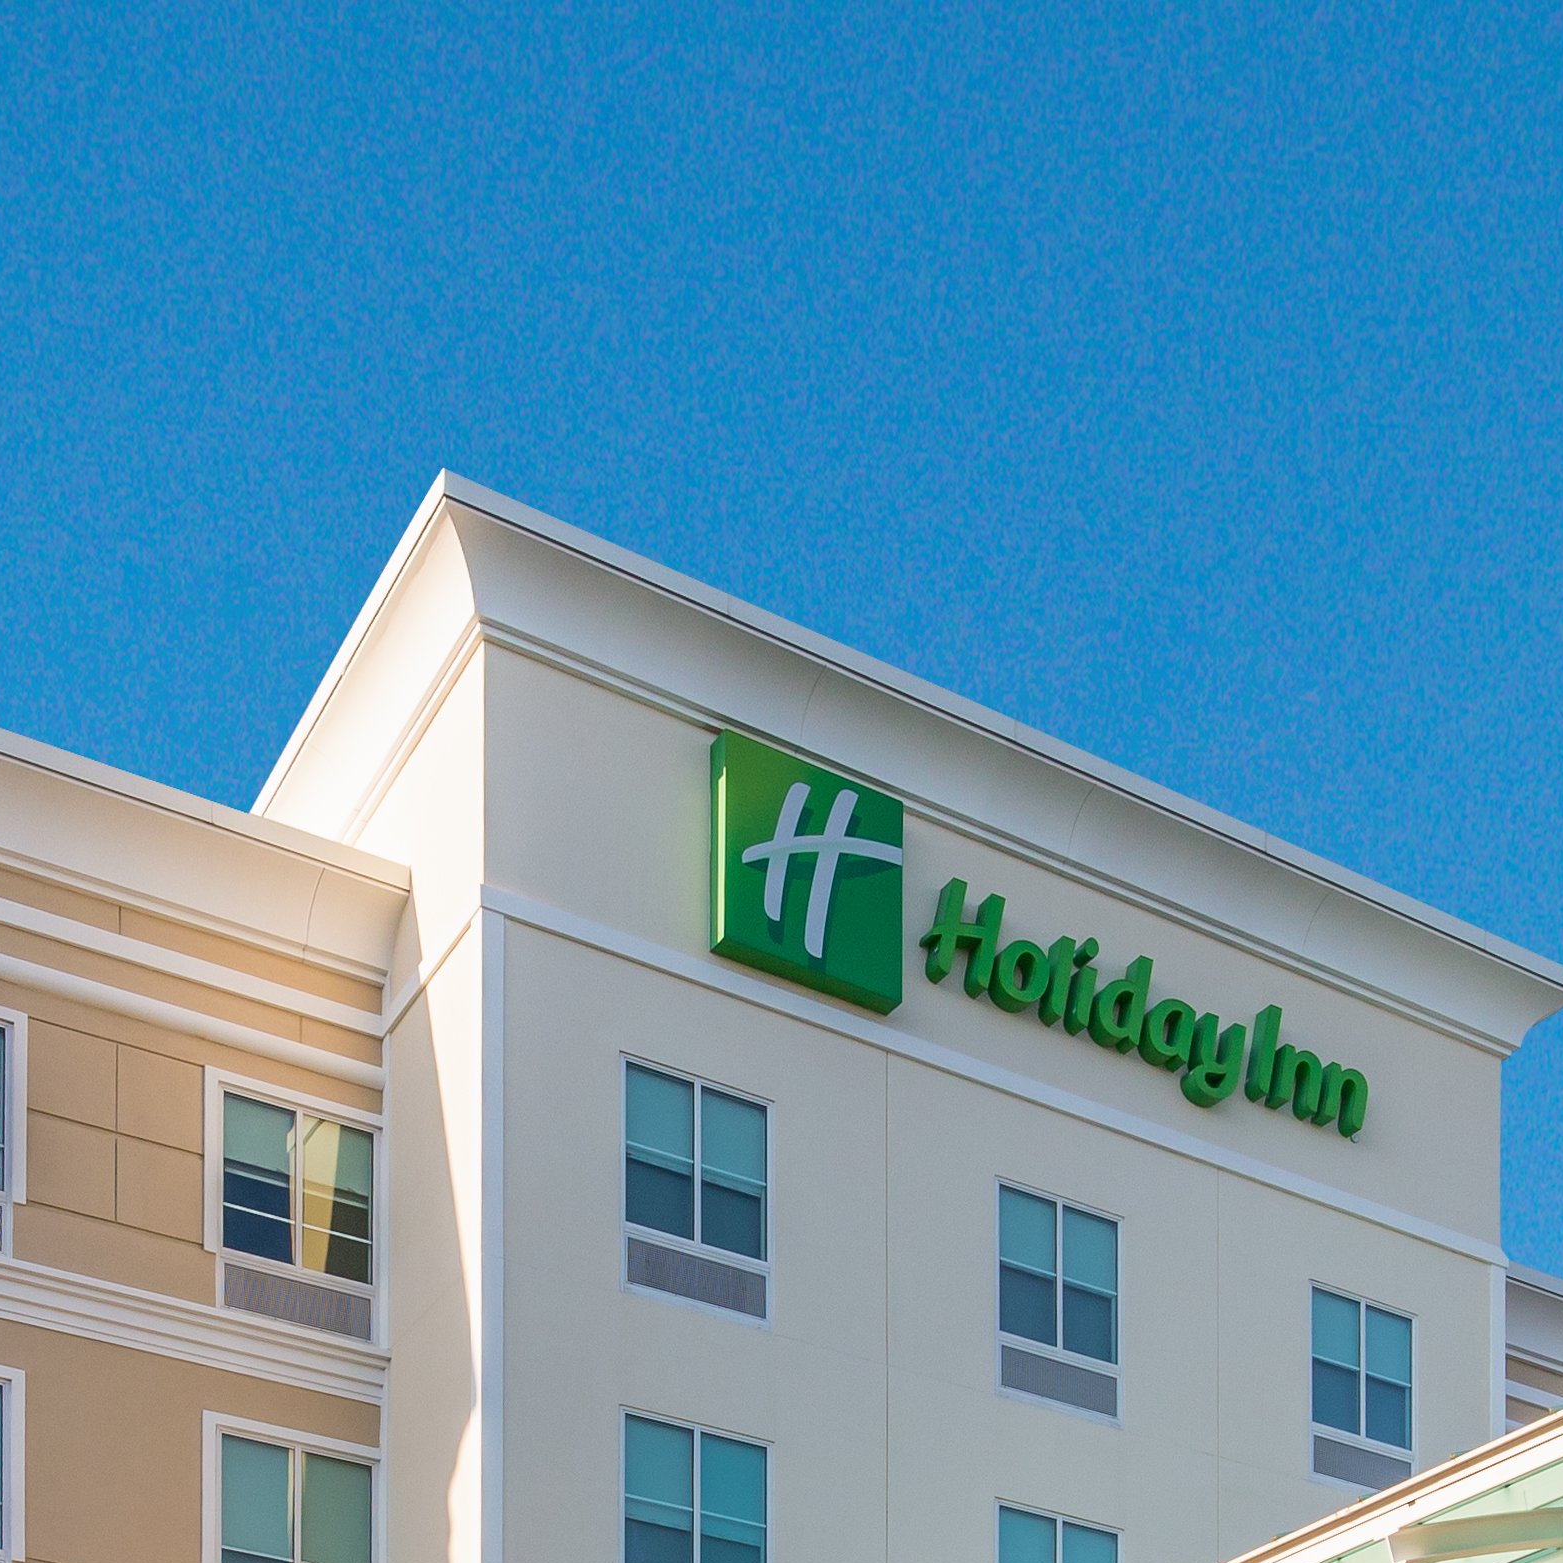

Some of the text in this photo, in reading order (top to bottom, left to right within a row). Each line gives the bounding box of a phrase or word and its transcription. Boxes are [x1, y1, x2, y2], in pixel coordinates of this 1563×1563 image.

[741, 782, 903, 959] H
[920, 877, 1368, 1138] Holiday Inn
